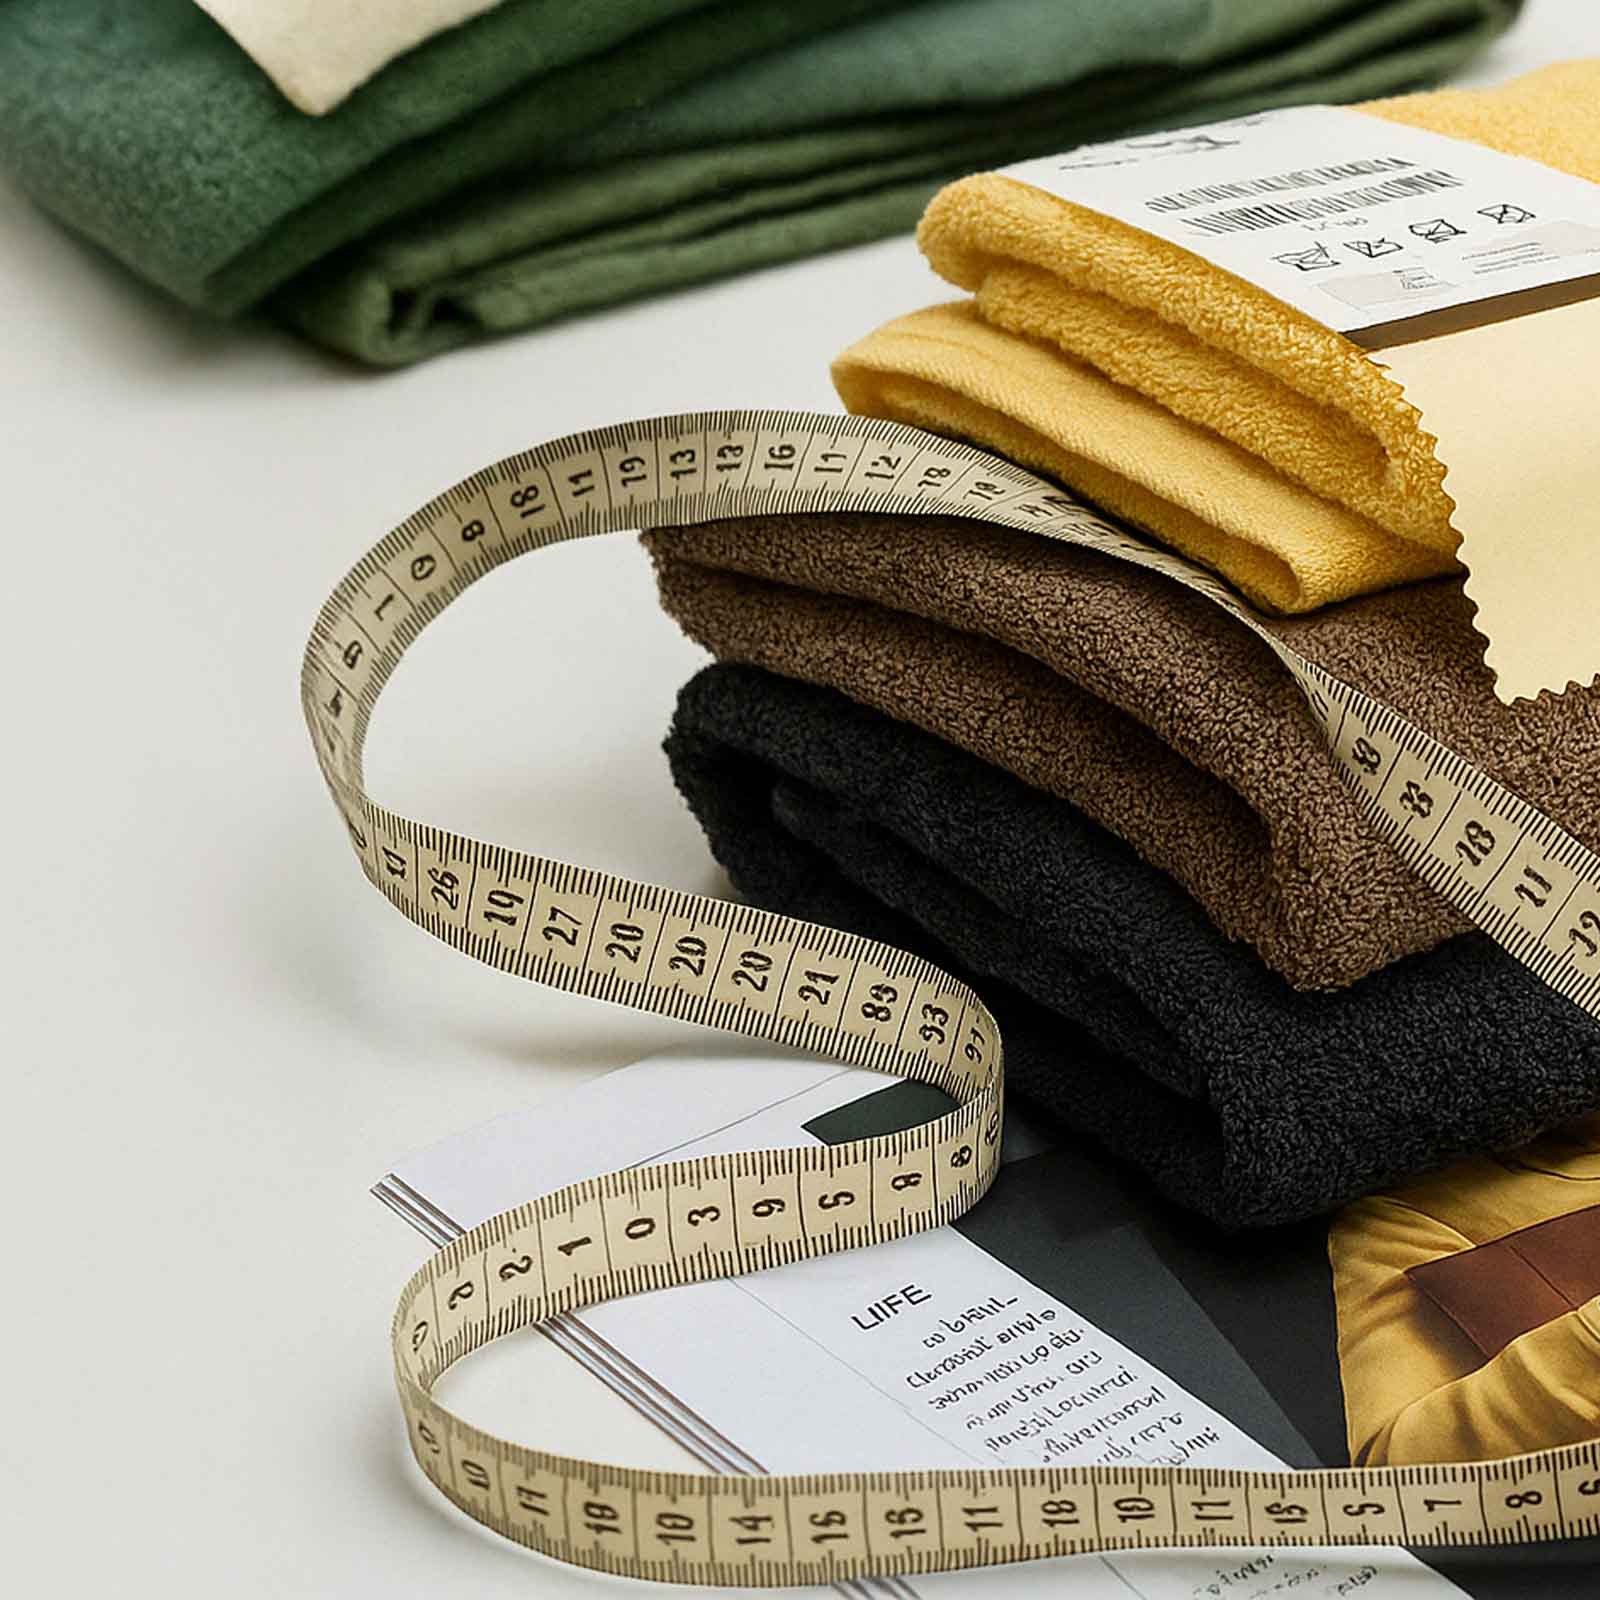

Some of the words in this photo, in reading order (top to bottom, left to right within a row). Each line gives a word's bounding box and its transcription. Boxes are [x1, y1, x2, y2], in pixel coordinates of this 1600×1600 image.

[669, 447, 698, 481] 13
[764, 444, 796, 472] 16
[510, 483, 546, 519] 18
[461, 519, 486, 544] 8
[427, 867, 460, 911] 26
[541, 905, 583, 947] 27
[604, 922, 644, 964] 20
[669, 935, 708, 977] 20
[731, 950, 774, 993] 20
[799, 970, 840, 1006] 21
[687, 1205, 721, 1227] 3
[752, 1198, 786, 1219] 9
[625, 1217, 656, 1240] 0
[557, 1236, 593, 1256] 1
[1042, 1499, 1081, 1529] 18
[1504, 1490, 1543, 1510] 8
[730, 1514, 774, 1546] 14
[962, 1505, 1004, 1533] 11
